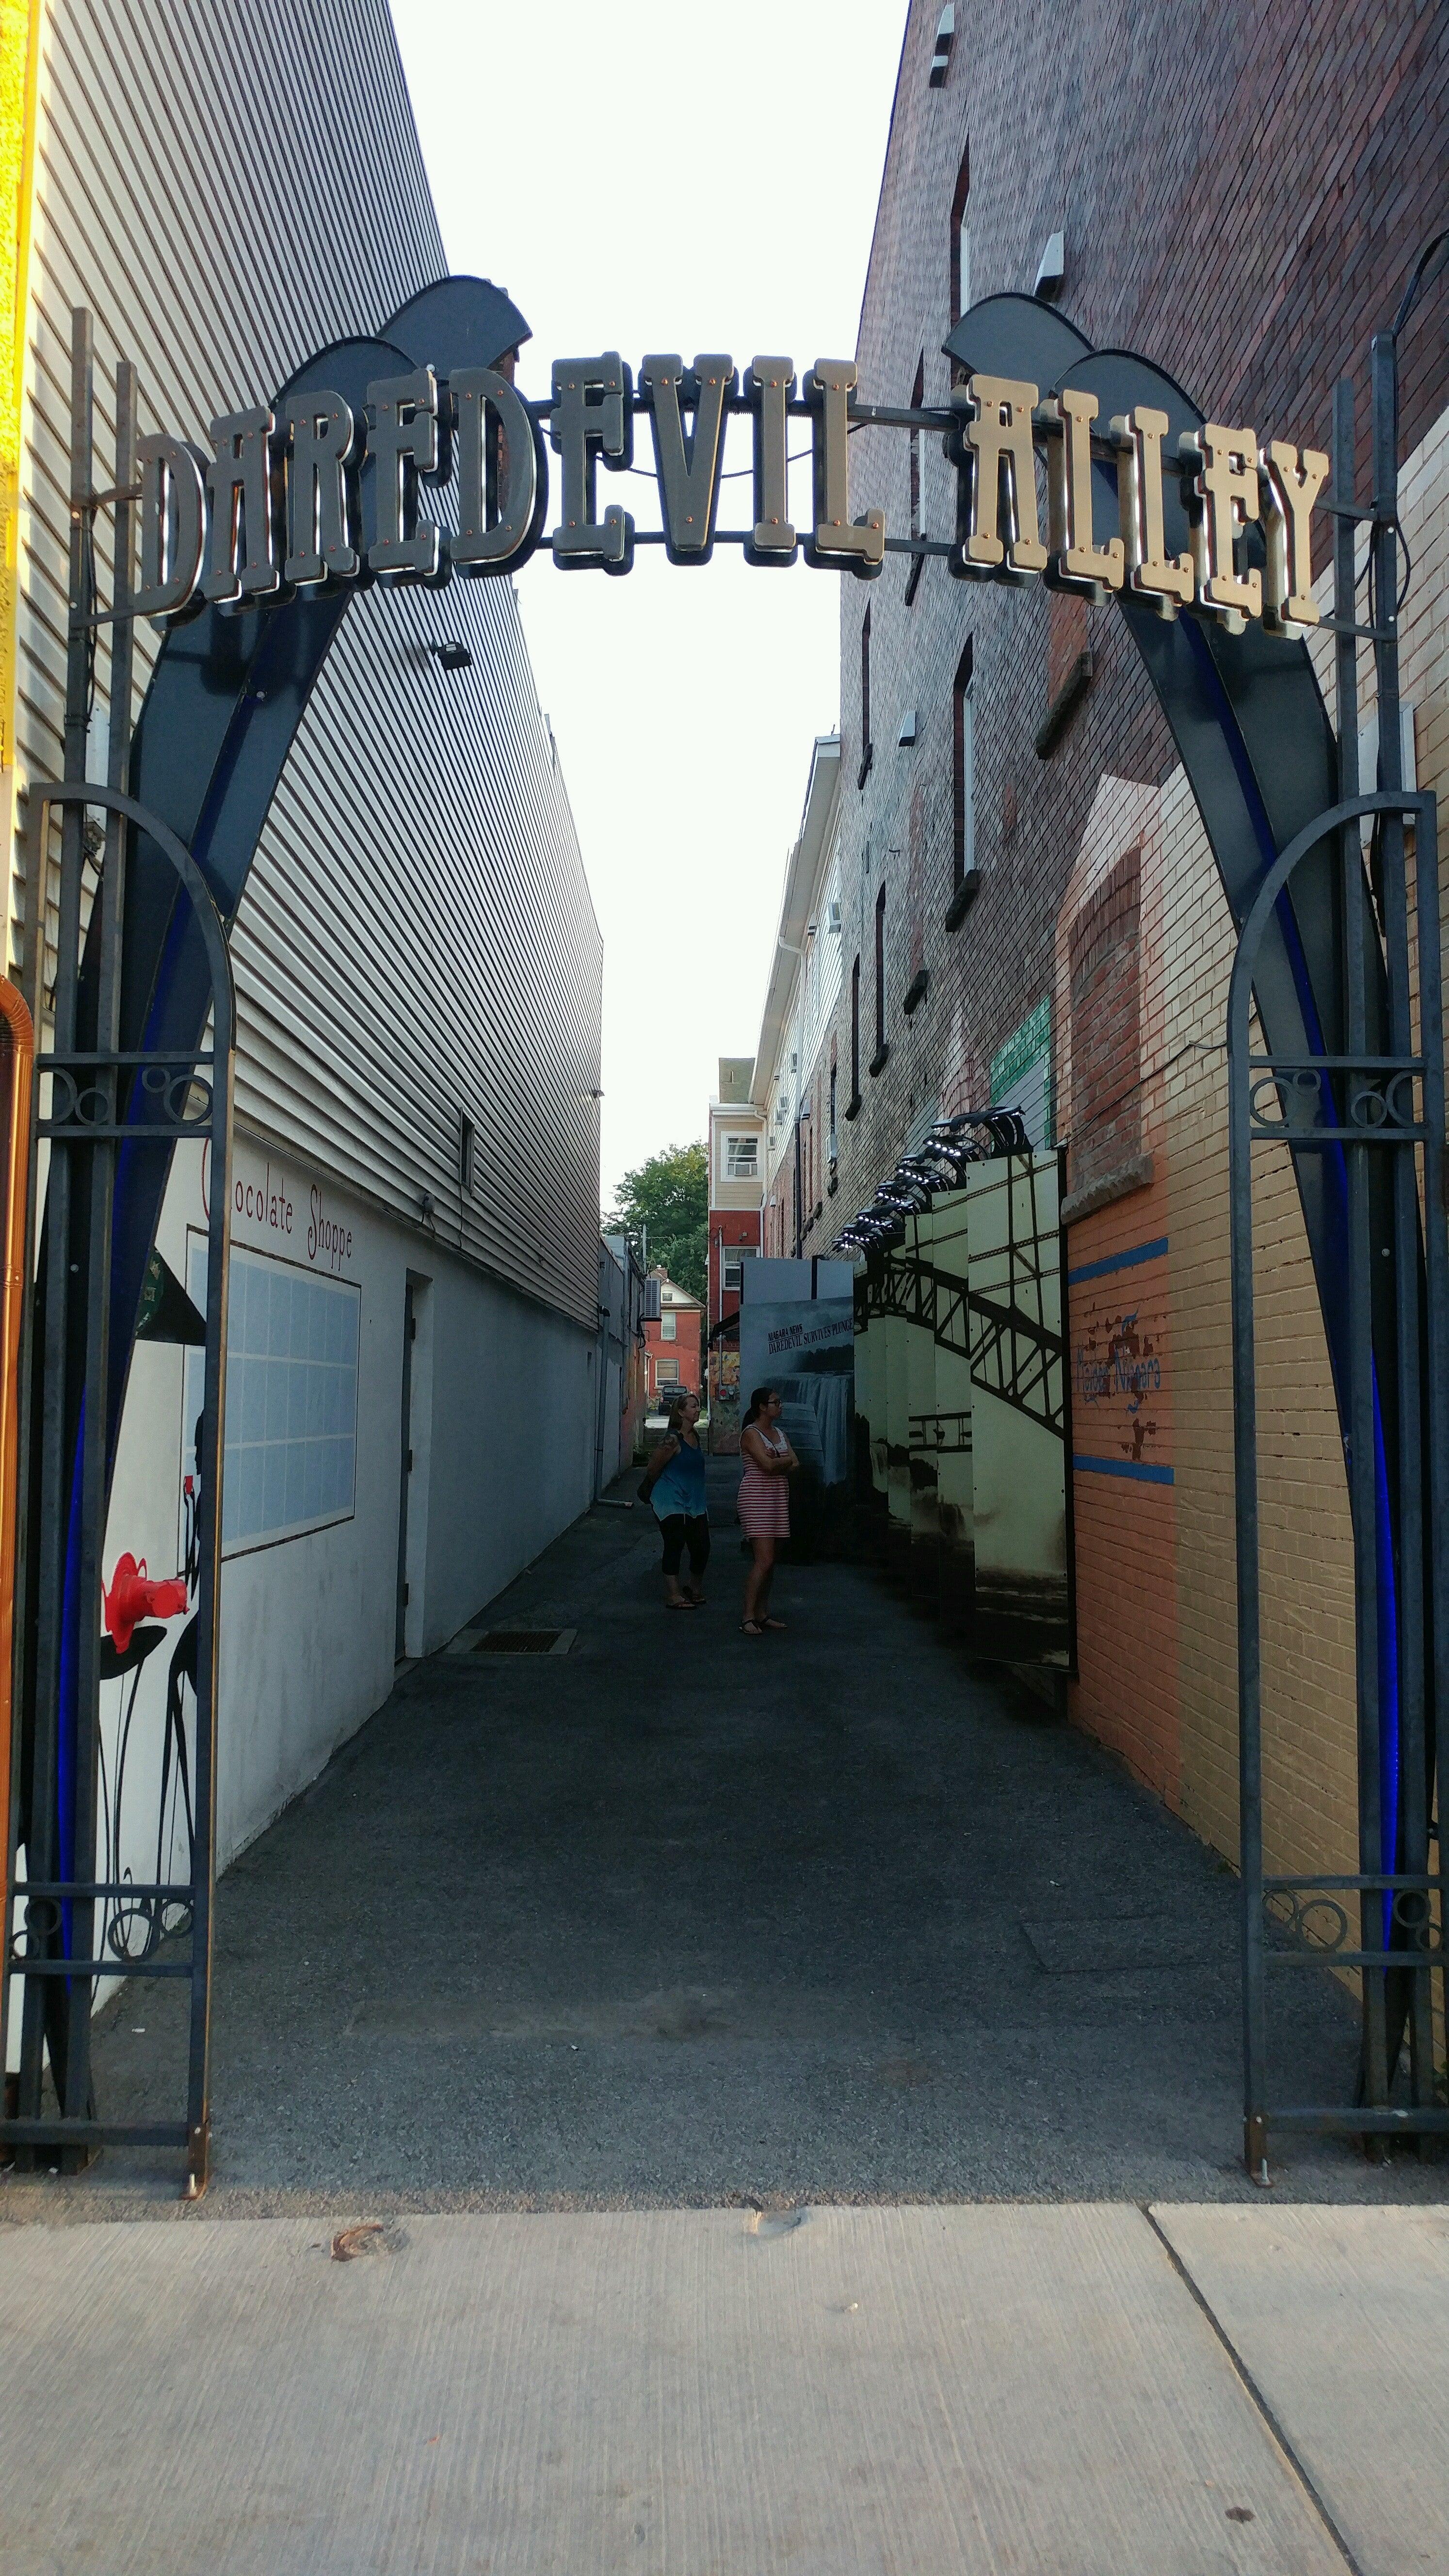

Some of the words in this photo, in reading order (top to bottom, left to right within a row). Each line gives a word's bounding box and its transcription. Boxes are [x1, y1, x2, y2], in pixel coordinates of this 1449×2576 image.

[133, 351, 886, 626] DAREDEVIL
[960, 373, 1330, 630] ALLEY
[308, 1184, 352, 1271] Shoppe
[768, 1327, 789, 1341] NIAGARA
[789, 1323, 803, 1335] NEWS
[769, 1335, 802, 1354] DAREDEVIL
[804, 1326, 831, 1344] SURVIVES
[832, 1318, 853, 1336] PLUNGE
